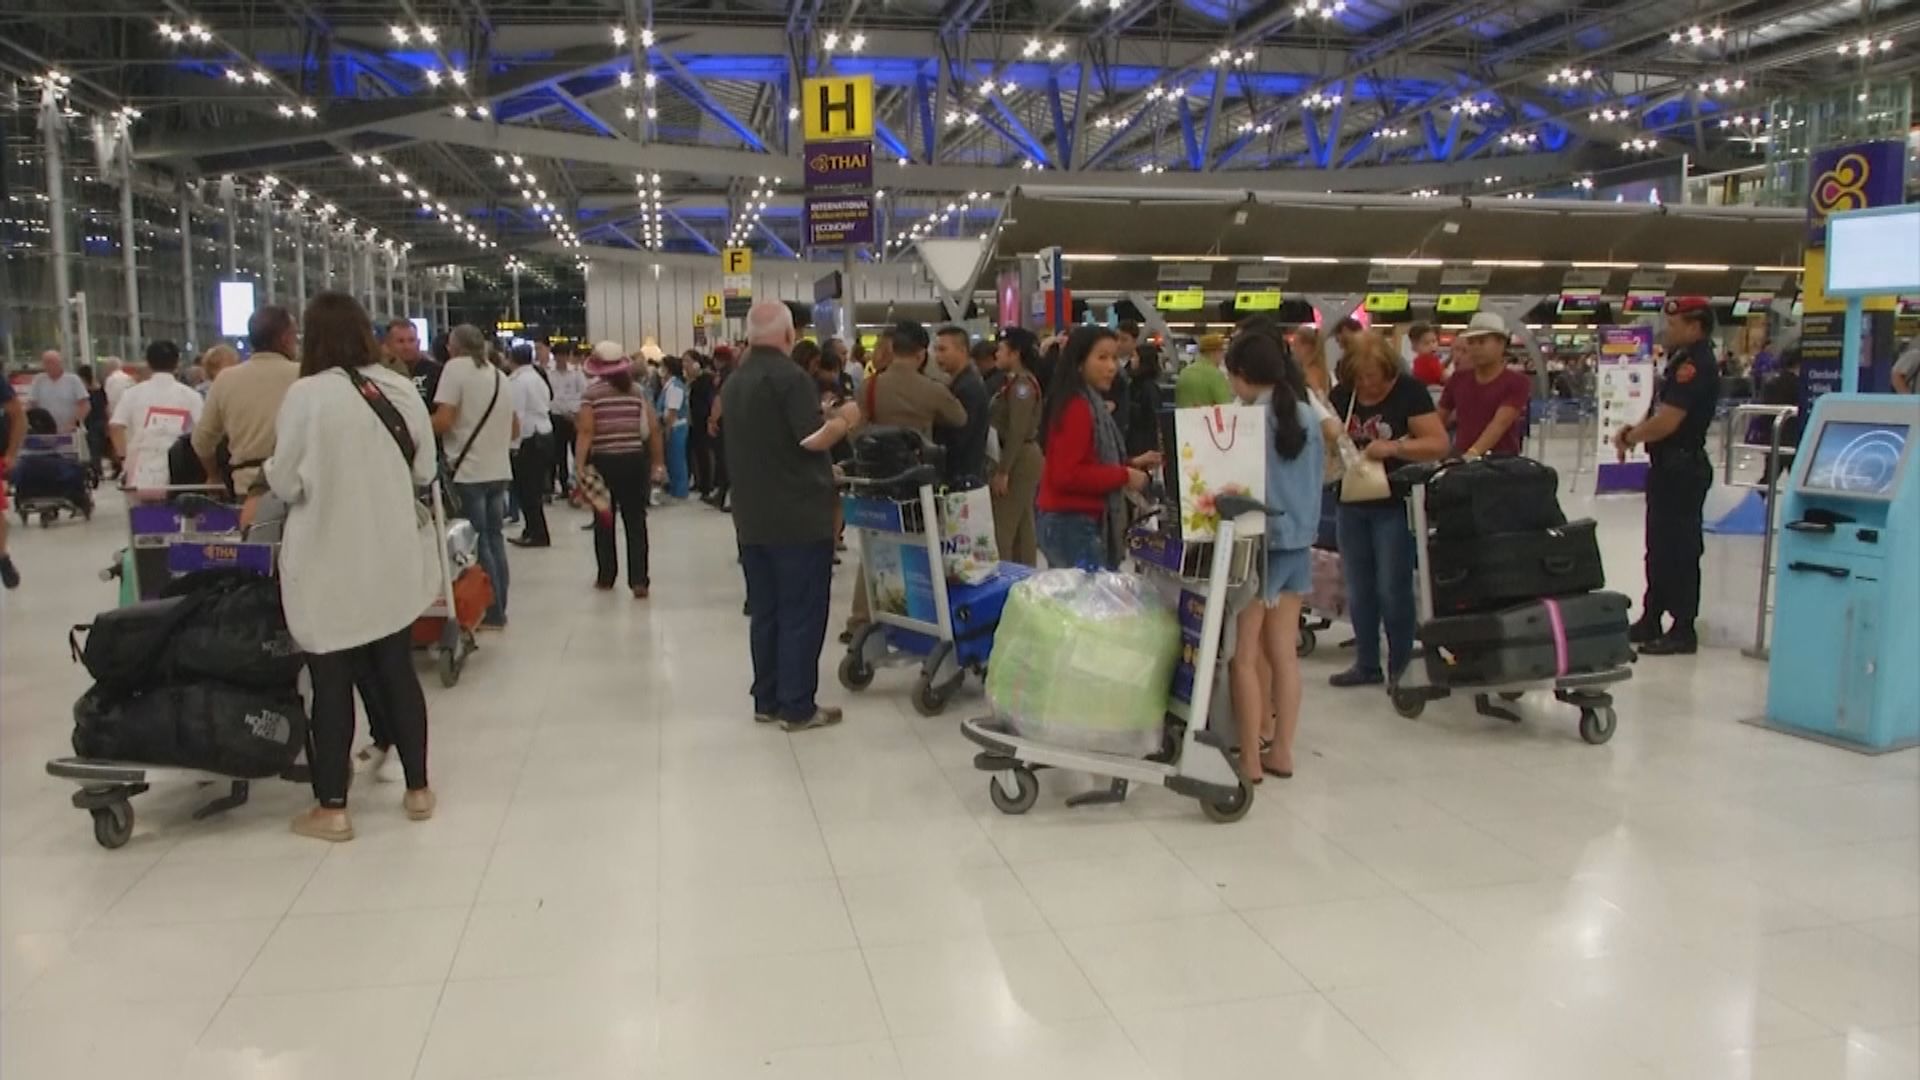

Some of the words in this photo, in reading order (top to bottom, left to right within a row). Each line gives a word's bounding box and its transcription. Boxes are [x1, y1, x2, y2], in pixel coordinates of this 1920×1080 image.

[820, 84, 854, 132] H
[830, 154, 867, 169] THAI
[810, 201, 868, 211] INTERNATIONAL
[815, 222, 855, 231] ECONOMY
[731, 252, 742, 271] F
[707, 295, 717, 307] D
[215, 547, 237, 559] THAI
